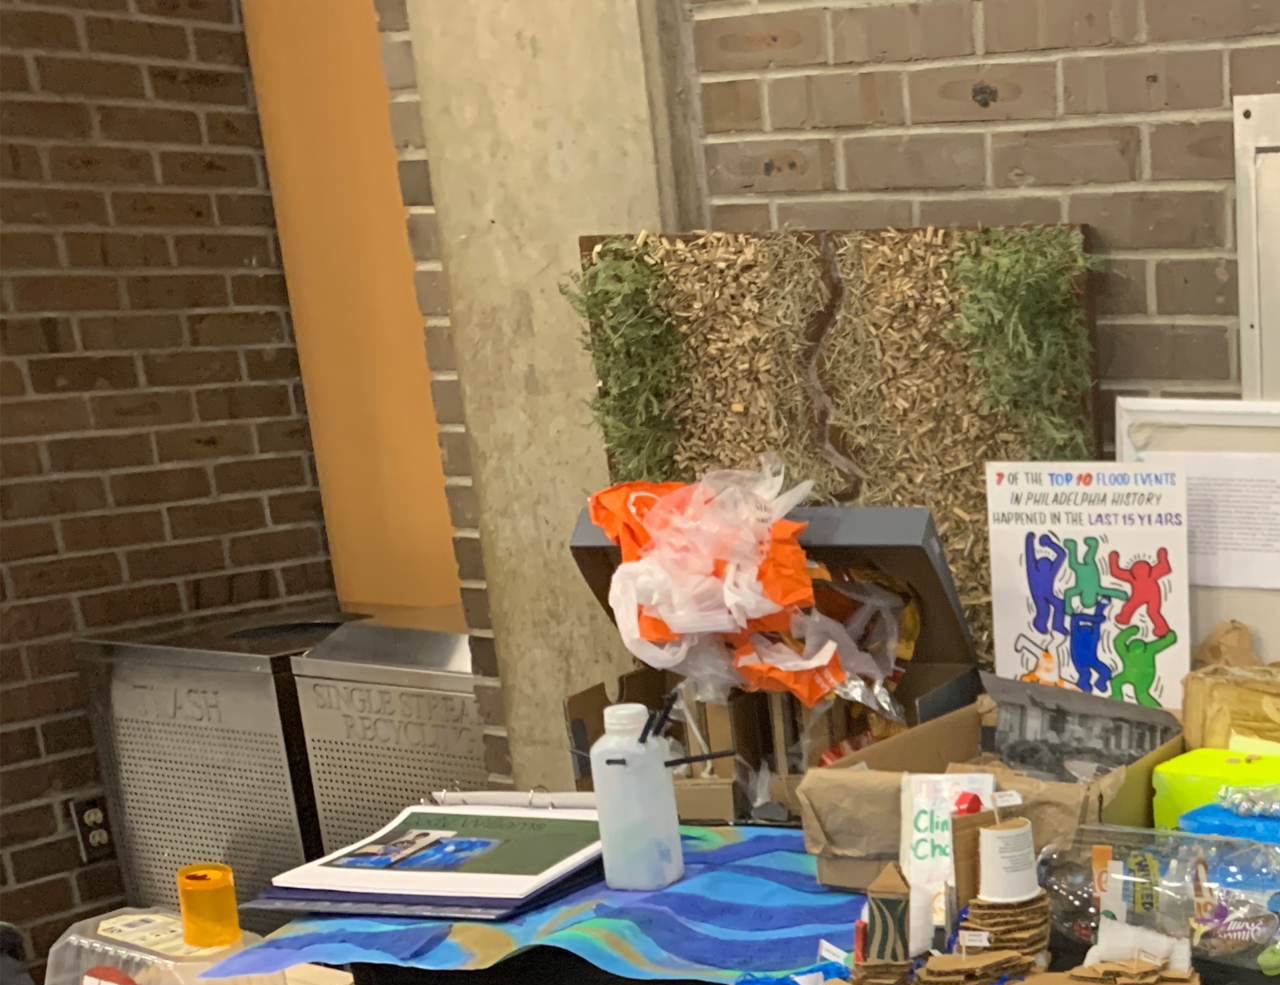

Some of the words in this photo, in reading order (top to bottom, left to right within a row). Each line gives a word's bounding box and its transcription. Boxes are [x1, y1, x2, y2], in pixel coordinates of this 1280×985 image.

[995, 472, 1005, 486] 7
[1007, 472, 1020, 486] OF
[1023, 472, 1043, 486] THE
[1047, 472, 1073, 487] TOP
[1075, 472, 1093, 487] 10
[1096, 472, 1131, 486] FLOOD
[1134, 472, 1177, 486] EVENTS
[1009, 491, 1024, 506] IN
[1024, 491, 1108, 506] PHILADELPHIA
[1110, 492, 1163, 506] HISTORY
[992, 511, 1047, 526] HAPPENED
[1050, 511, 1062, 526] IN
[1064, 511, 1084, 526] THE
[1088, 512, 1119, 526] LAST
[1122, 513, 1136, 526] 15
[1137, 512, 1183, 527] YEARS
[312, 683, 396, 717] SINGLE
